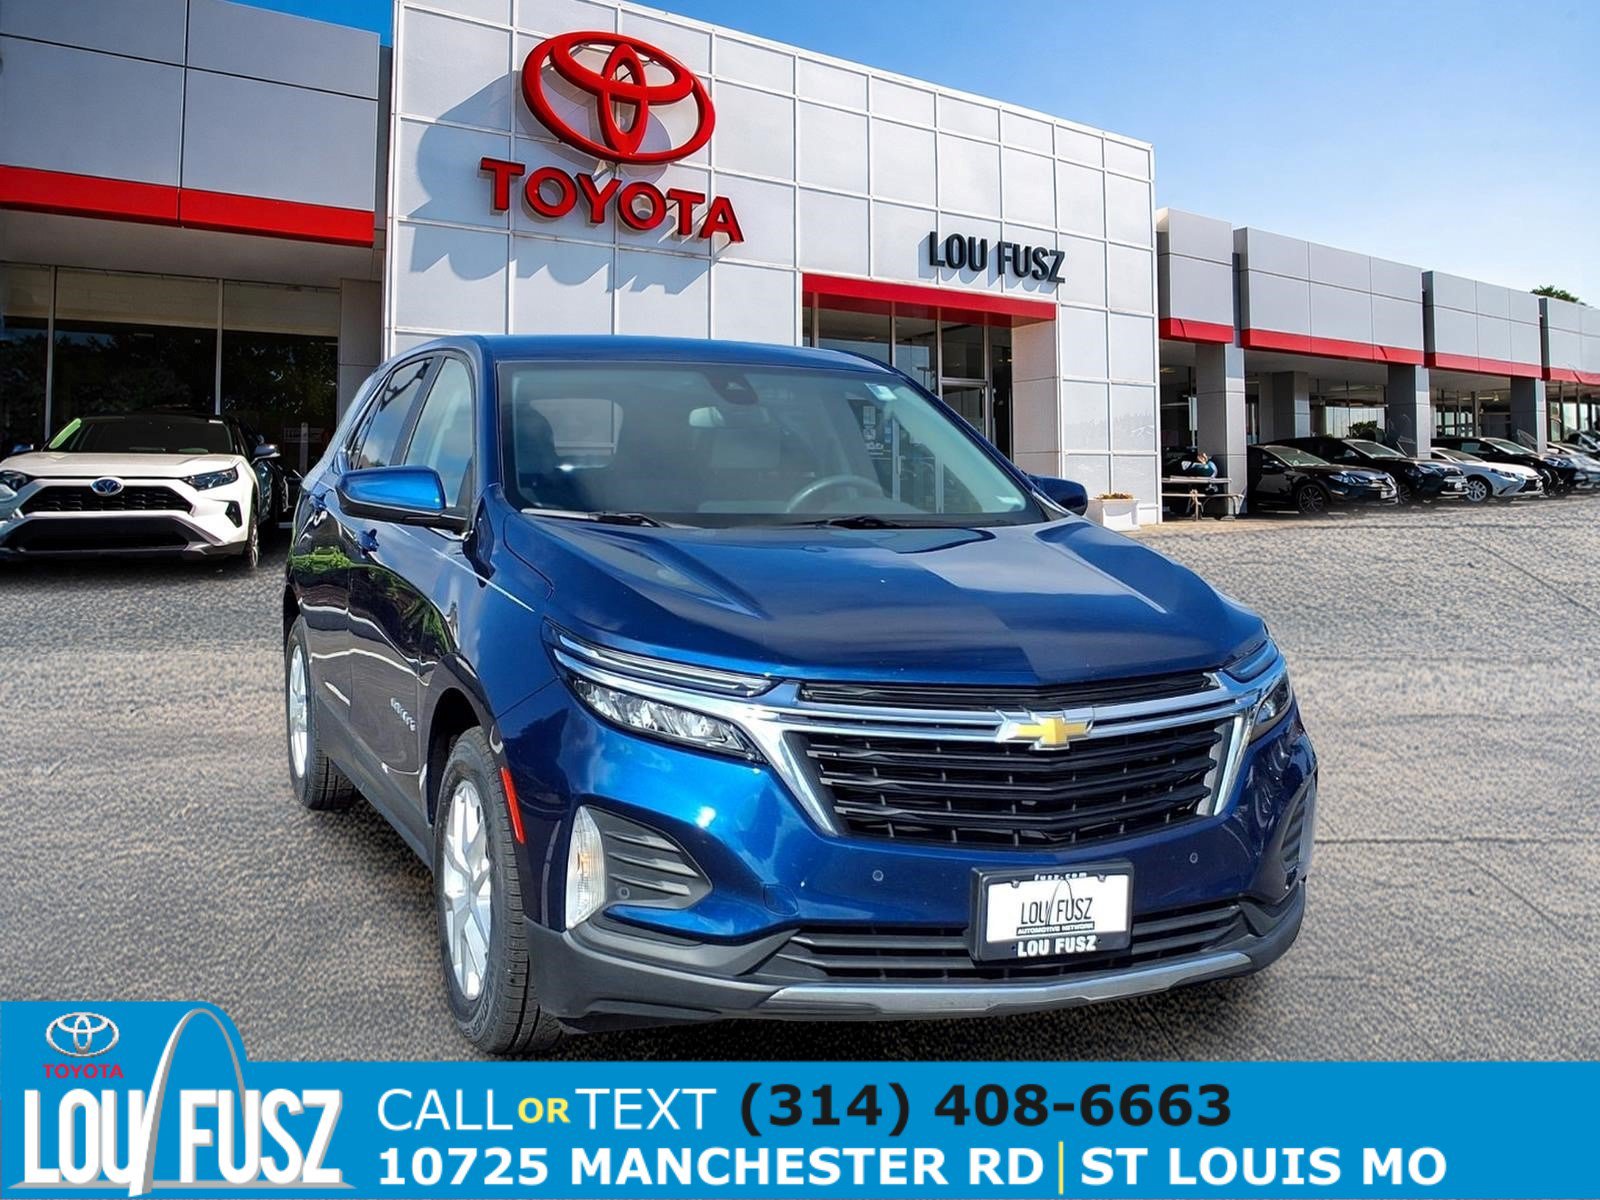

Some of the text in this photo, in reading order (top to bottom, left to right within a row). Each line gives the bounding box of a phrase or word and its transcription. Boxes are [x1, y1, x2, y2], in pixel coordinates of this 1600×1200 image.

[480, 157, 744, 243] TOYOTA
[929, 231, 1065, 284] LOU FUSZ
[1021, 897, 1092, 924] LOU FUSZ
[1018, 935, 1096, 957] LOU FUSZ
